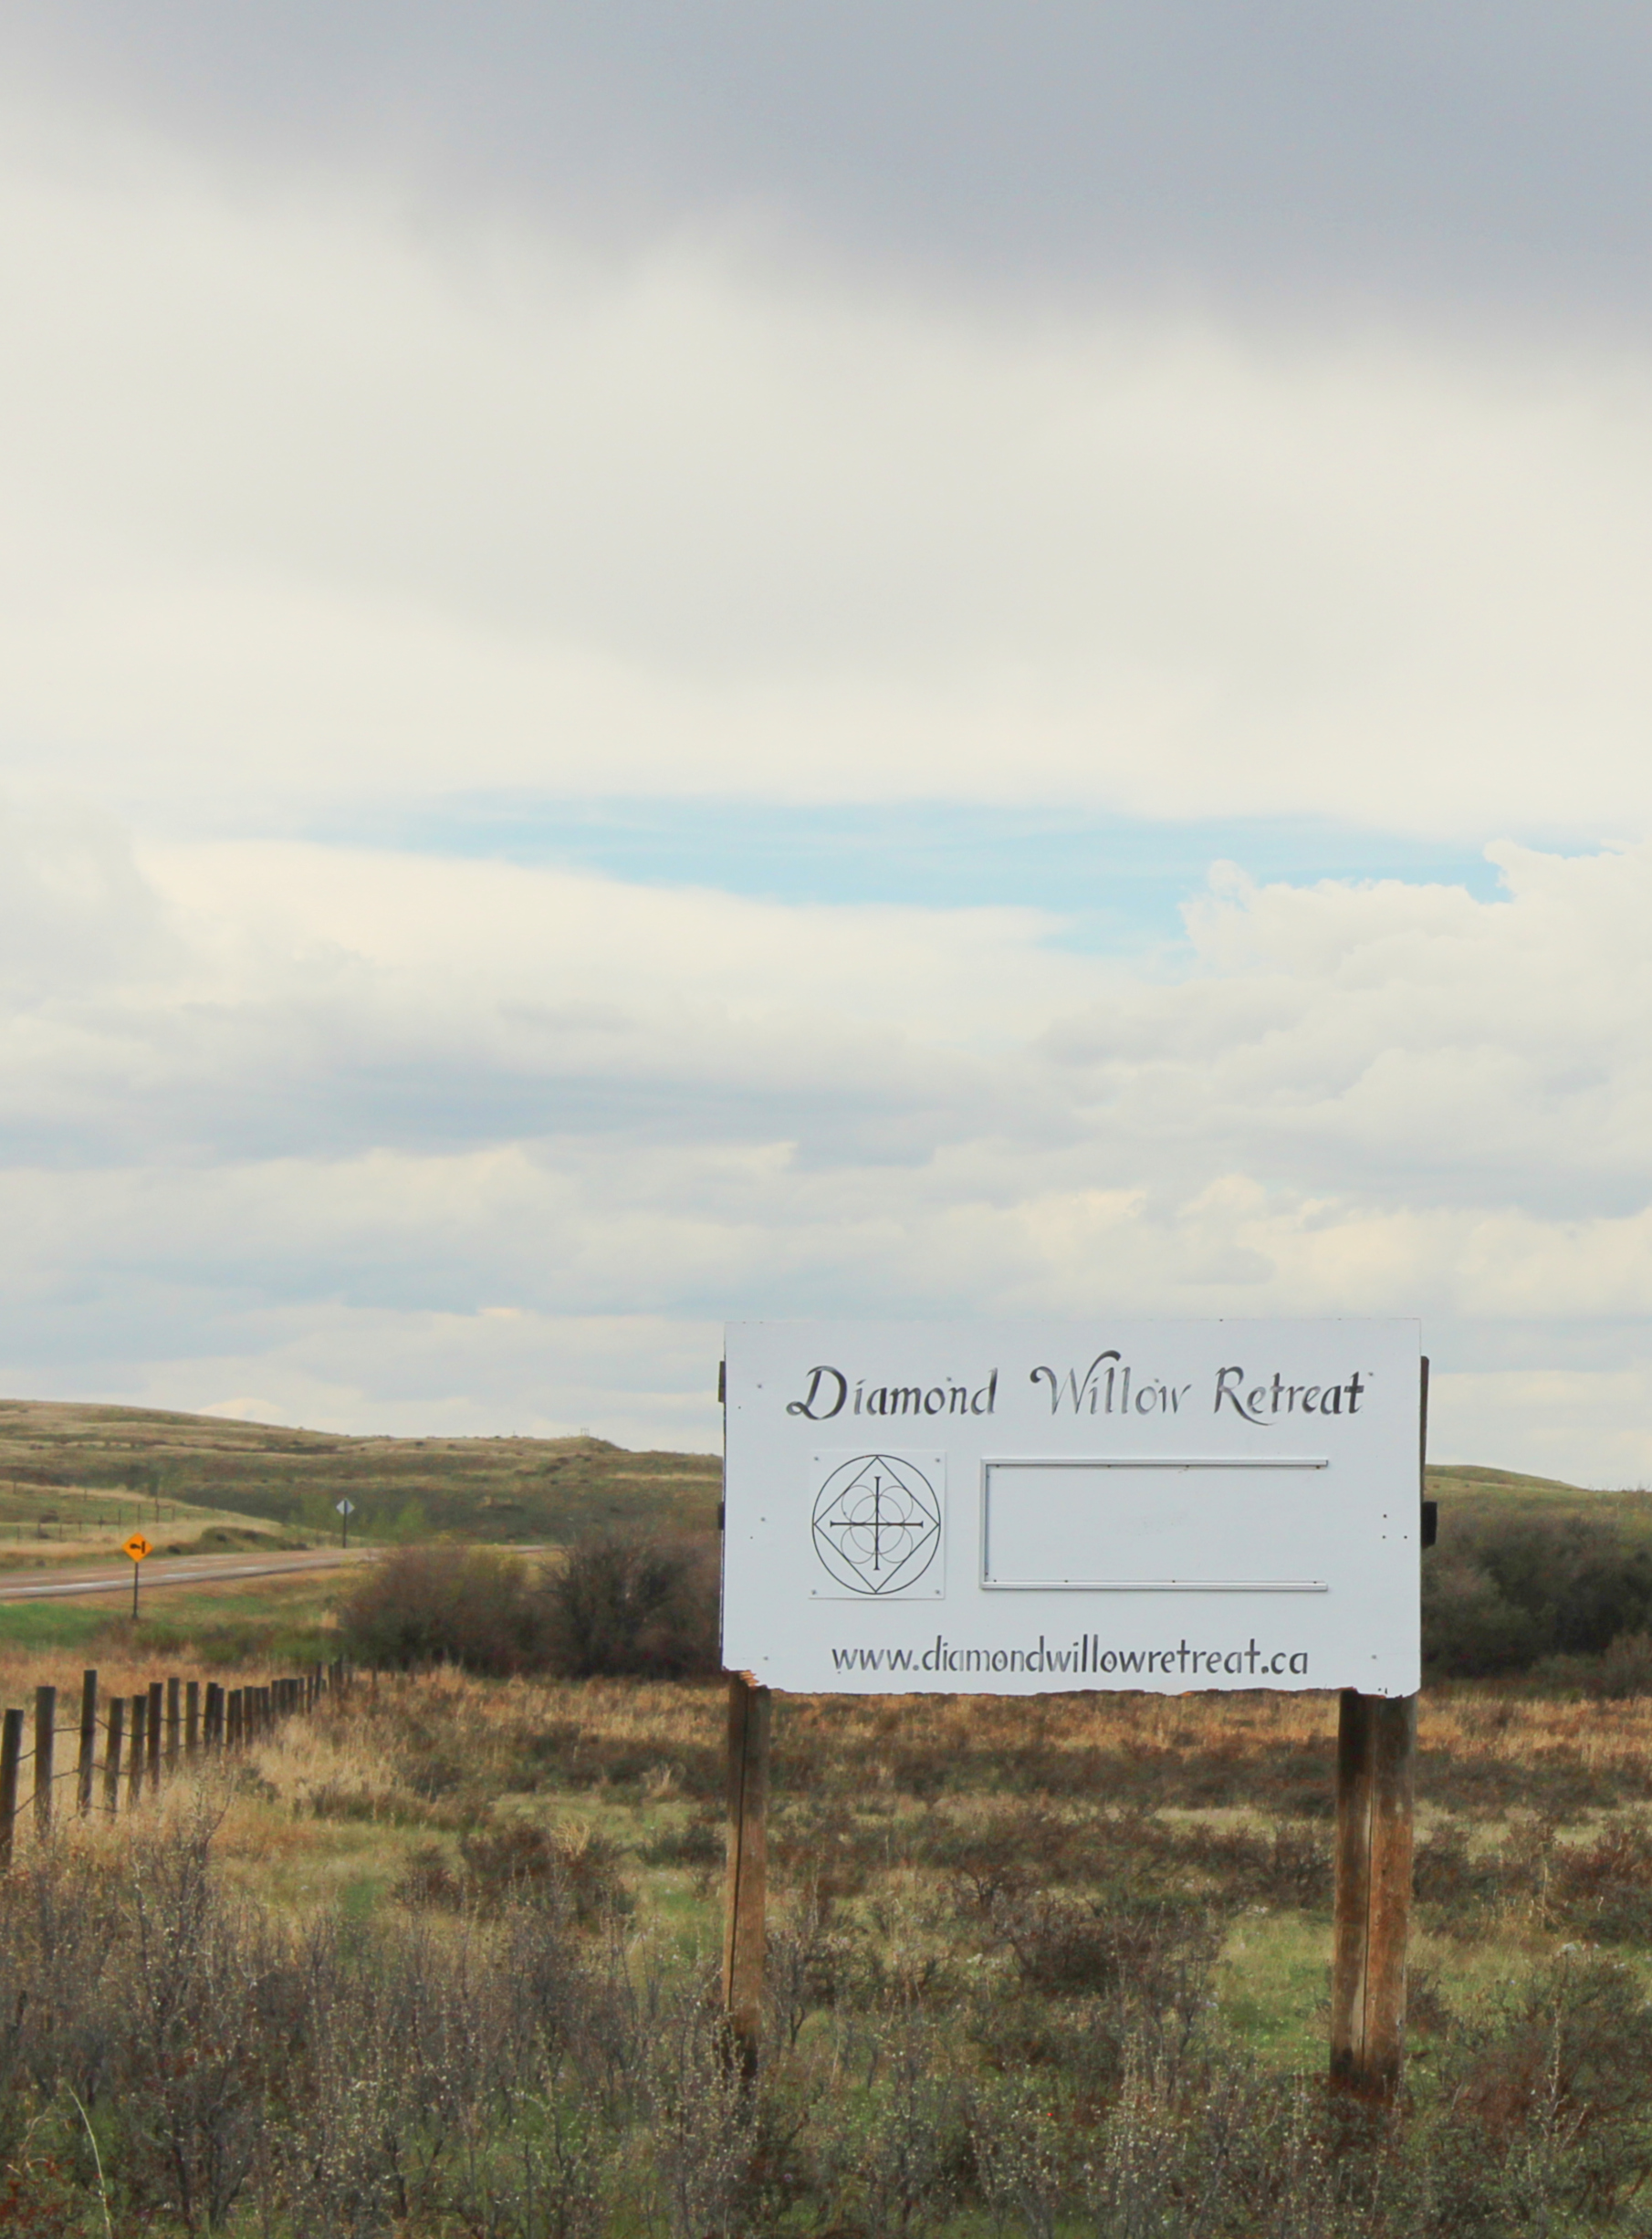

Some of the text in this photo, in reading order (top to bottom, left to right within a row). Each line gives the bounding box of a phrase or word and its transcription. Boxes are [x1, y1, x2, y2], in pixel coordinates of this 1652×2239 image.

[786, 1349, 1364, 1427] Diamond Willow Retreat
[831, 1633, 1309, 1675] www.diamondwillowretreat.ca
